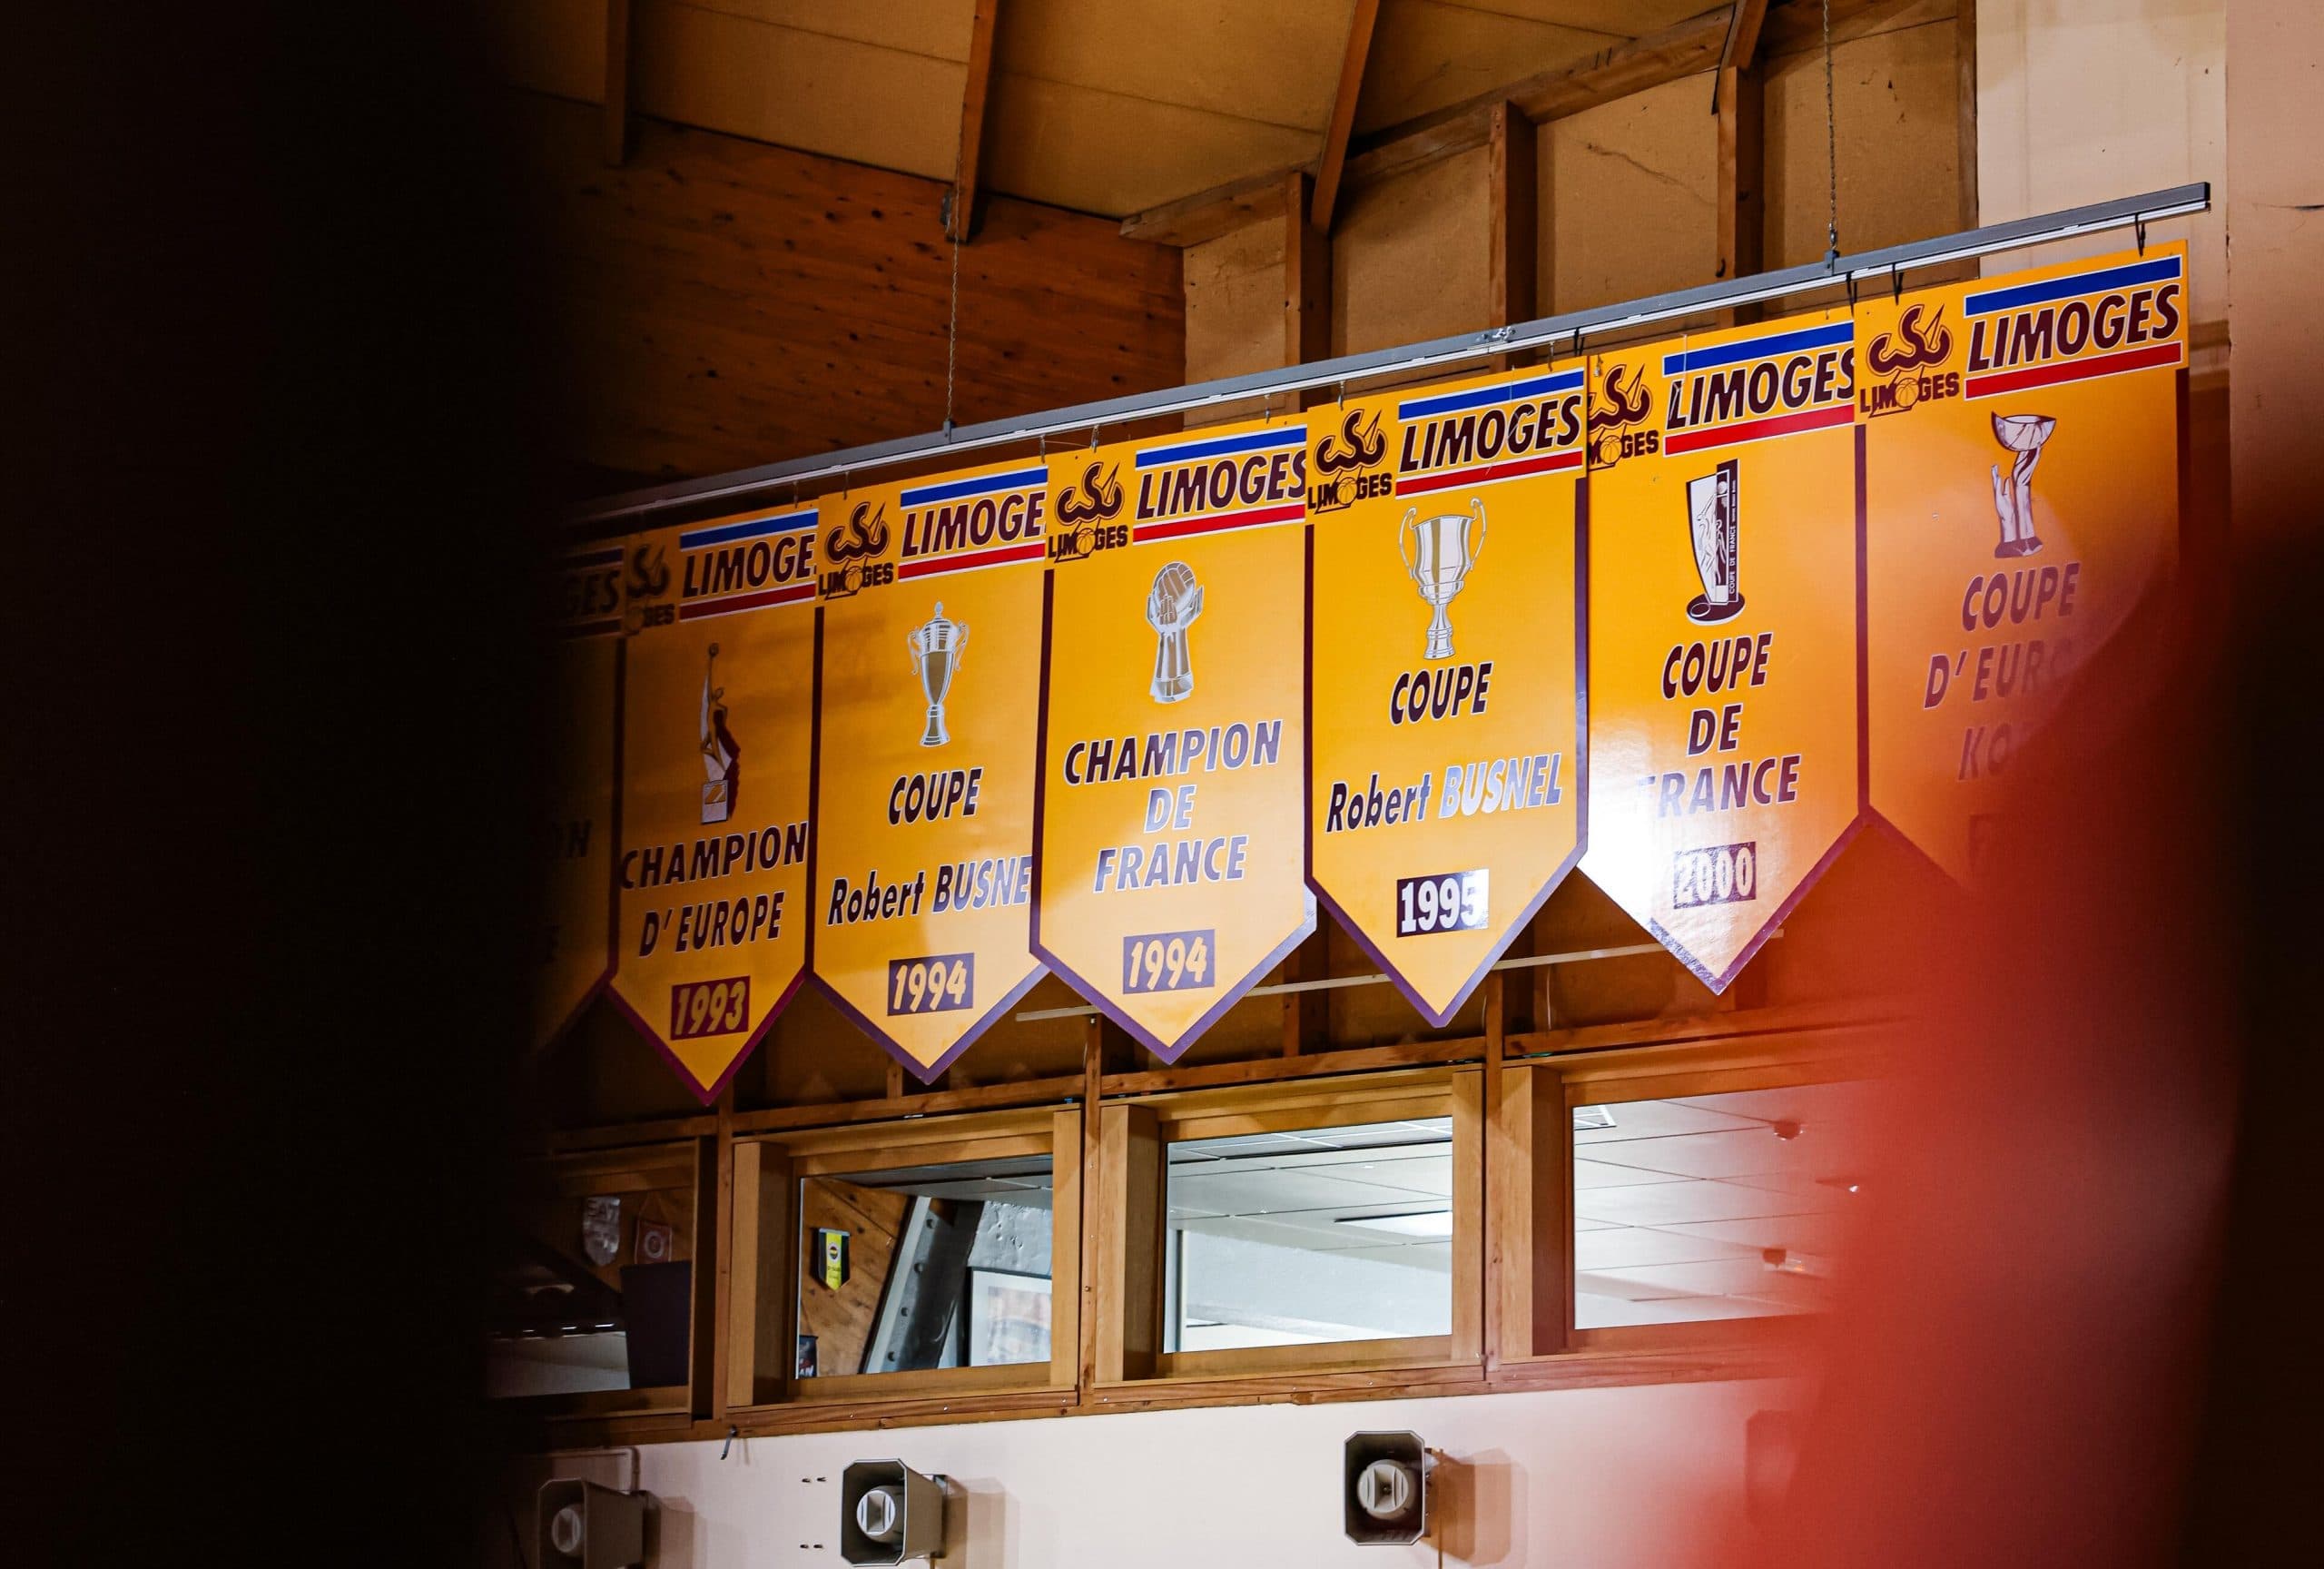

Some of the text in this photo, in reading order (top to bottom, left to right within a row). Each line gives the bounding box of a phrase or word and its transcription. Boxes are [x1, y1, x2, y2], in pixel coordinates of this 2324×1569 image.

[1966, 283, 2181, 373] LIMOGES
[1666, 346, 1854, 430] LIMOGES
[1859, 371, 1960, 412] LIMOGES
[1398, 393, 1583, 473] LIMOGES
[1588, 429, 1659, 466] MOGES
[1136, 449, 1306, 520] LIMOGES
[1307, 472, 1392, 510] LIMOGES
[901, 490, 1047, 558] LIMOGE
[1048, 525, 1128, 559] LIMOGES
[682, 533, 817, 598] LIMOGE
[1961, 561, 2081, 633] COUPE
[1389, 661, 1494, 726] COUPE
[1660, 631, 1773, 700] COUPE
[1063, 719, 1284, 785] CHAMPION
[1687, 703, 1743, 756] DE
[887, 766, 984, 826] COUPE
[1144, 784, 1197, 834] DE
[1325, 752, 1562, 834] Robert BUSNEL
[618, 820, 809, 890] CHAMPION
[1093, 834, 1249, 894] FRANCE
[1677, 845, 1756, 904] 2000
[827, 855, 1033, 926] Robert BUSNE
[1400, 876, 1486, 934] 1995
[638, 891, 785, 959] D'EUROPE
[892, 959, 968, 1012] 1994
[1128, 936, 1208, 992] 1994
[674, 980, 746, 1037] 1993
